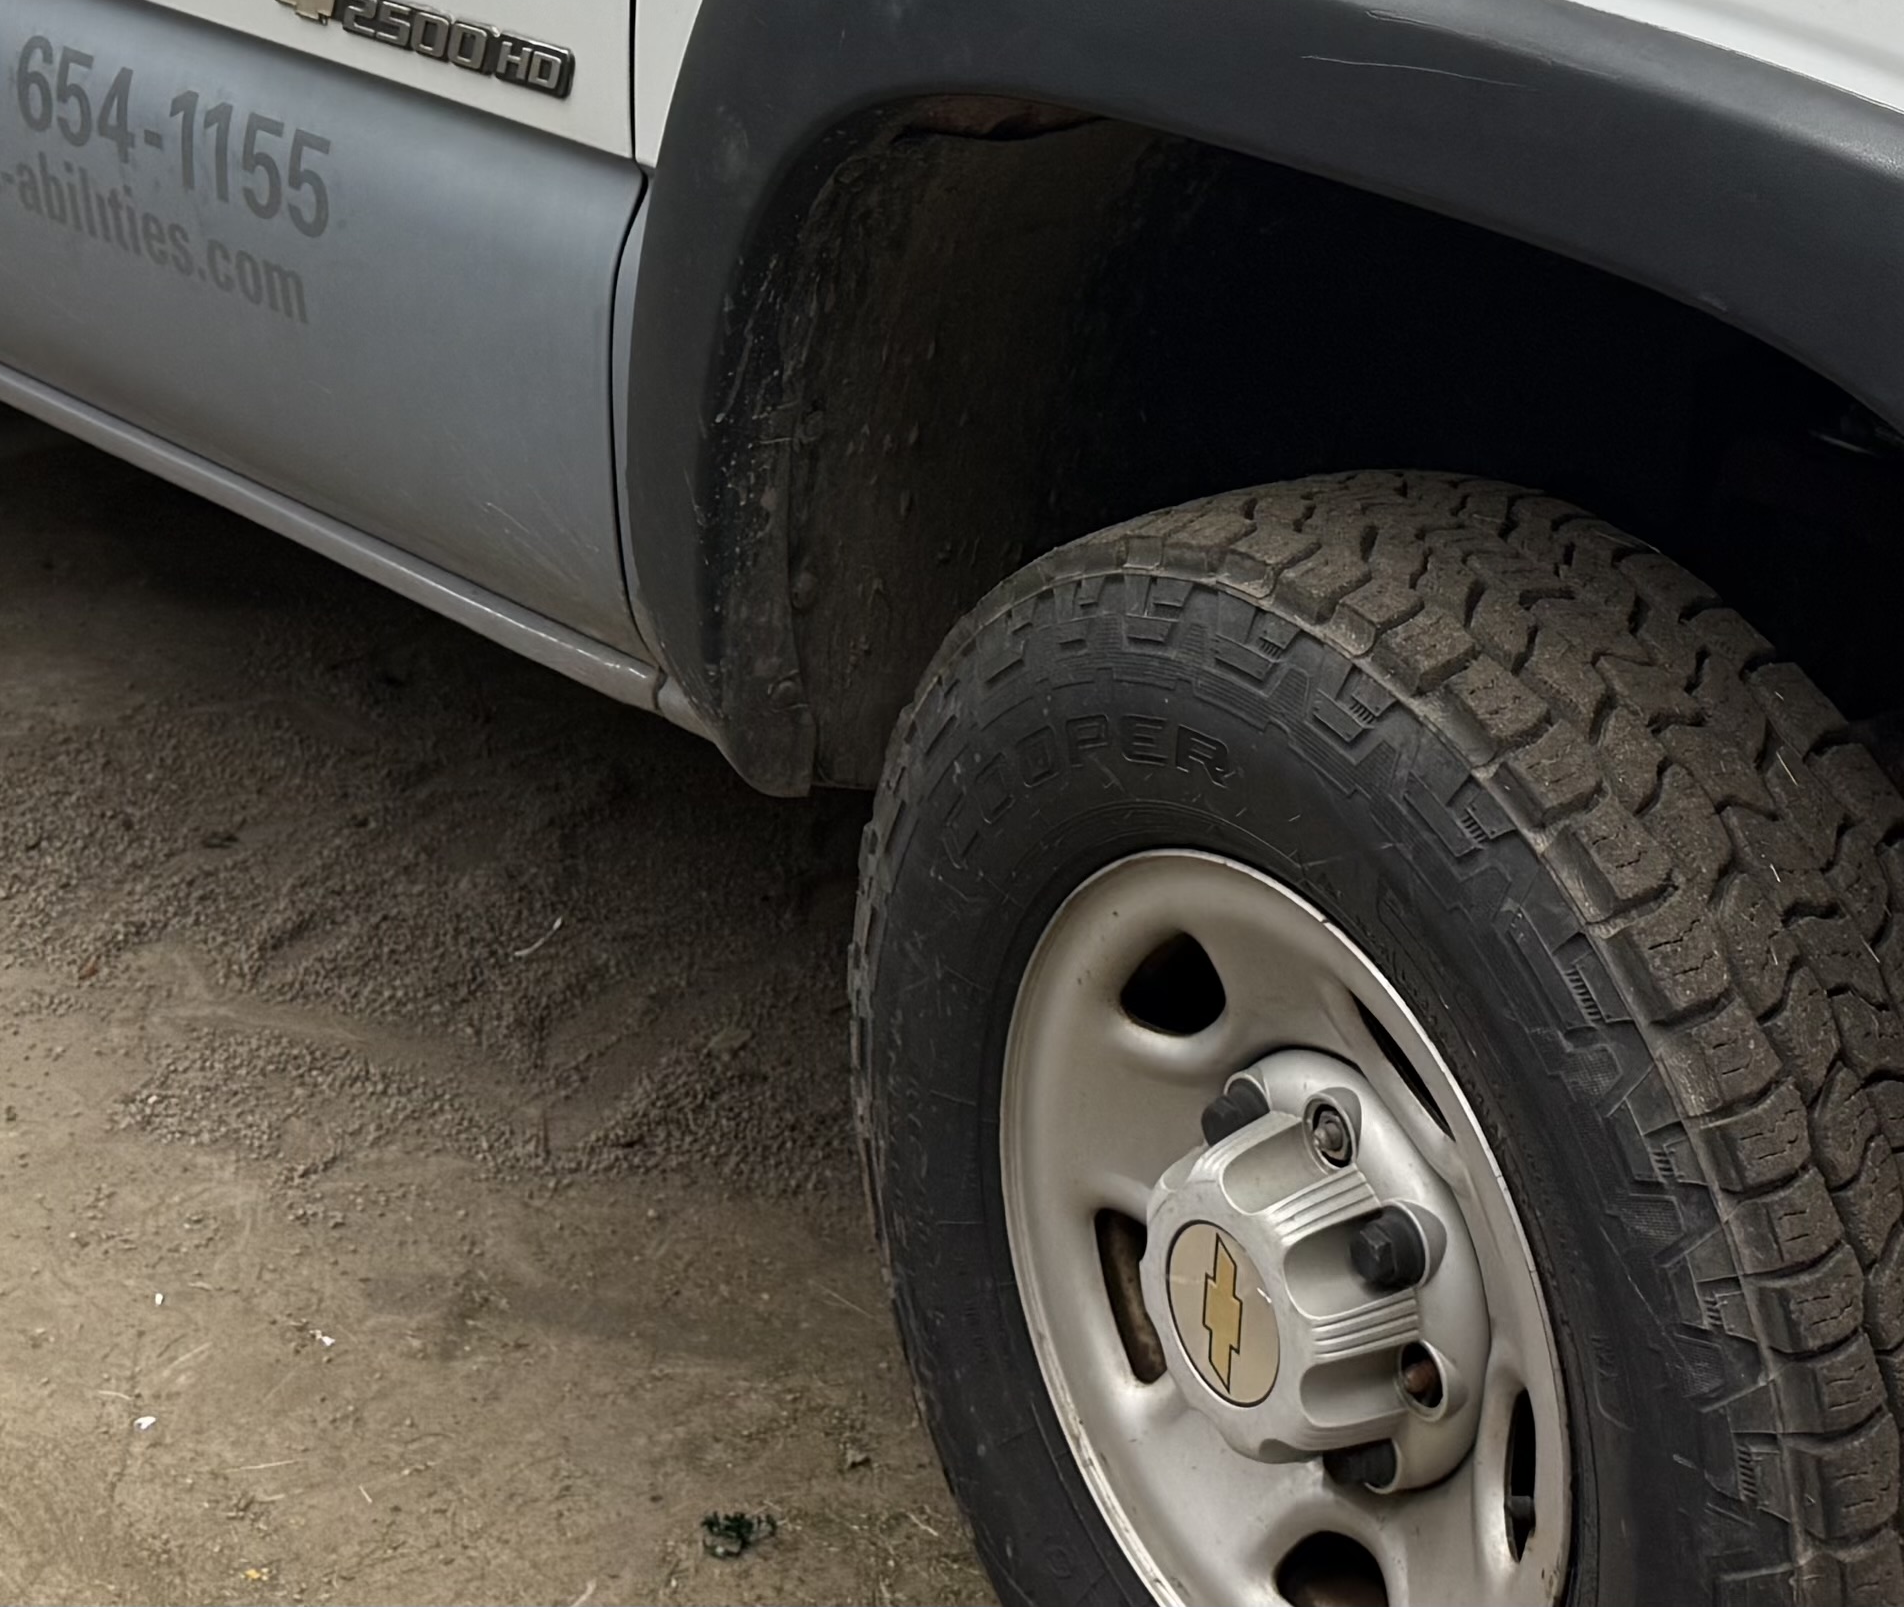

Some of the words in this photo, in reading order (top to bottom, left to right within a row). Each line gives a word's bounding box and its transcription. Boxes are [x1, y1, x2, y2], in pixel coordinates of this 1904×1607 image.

[16, 34, 332, 239] 654-1155
[496, 40, 562, 90] HD
[941, 713, 1230, 871] COOPER
